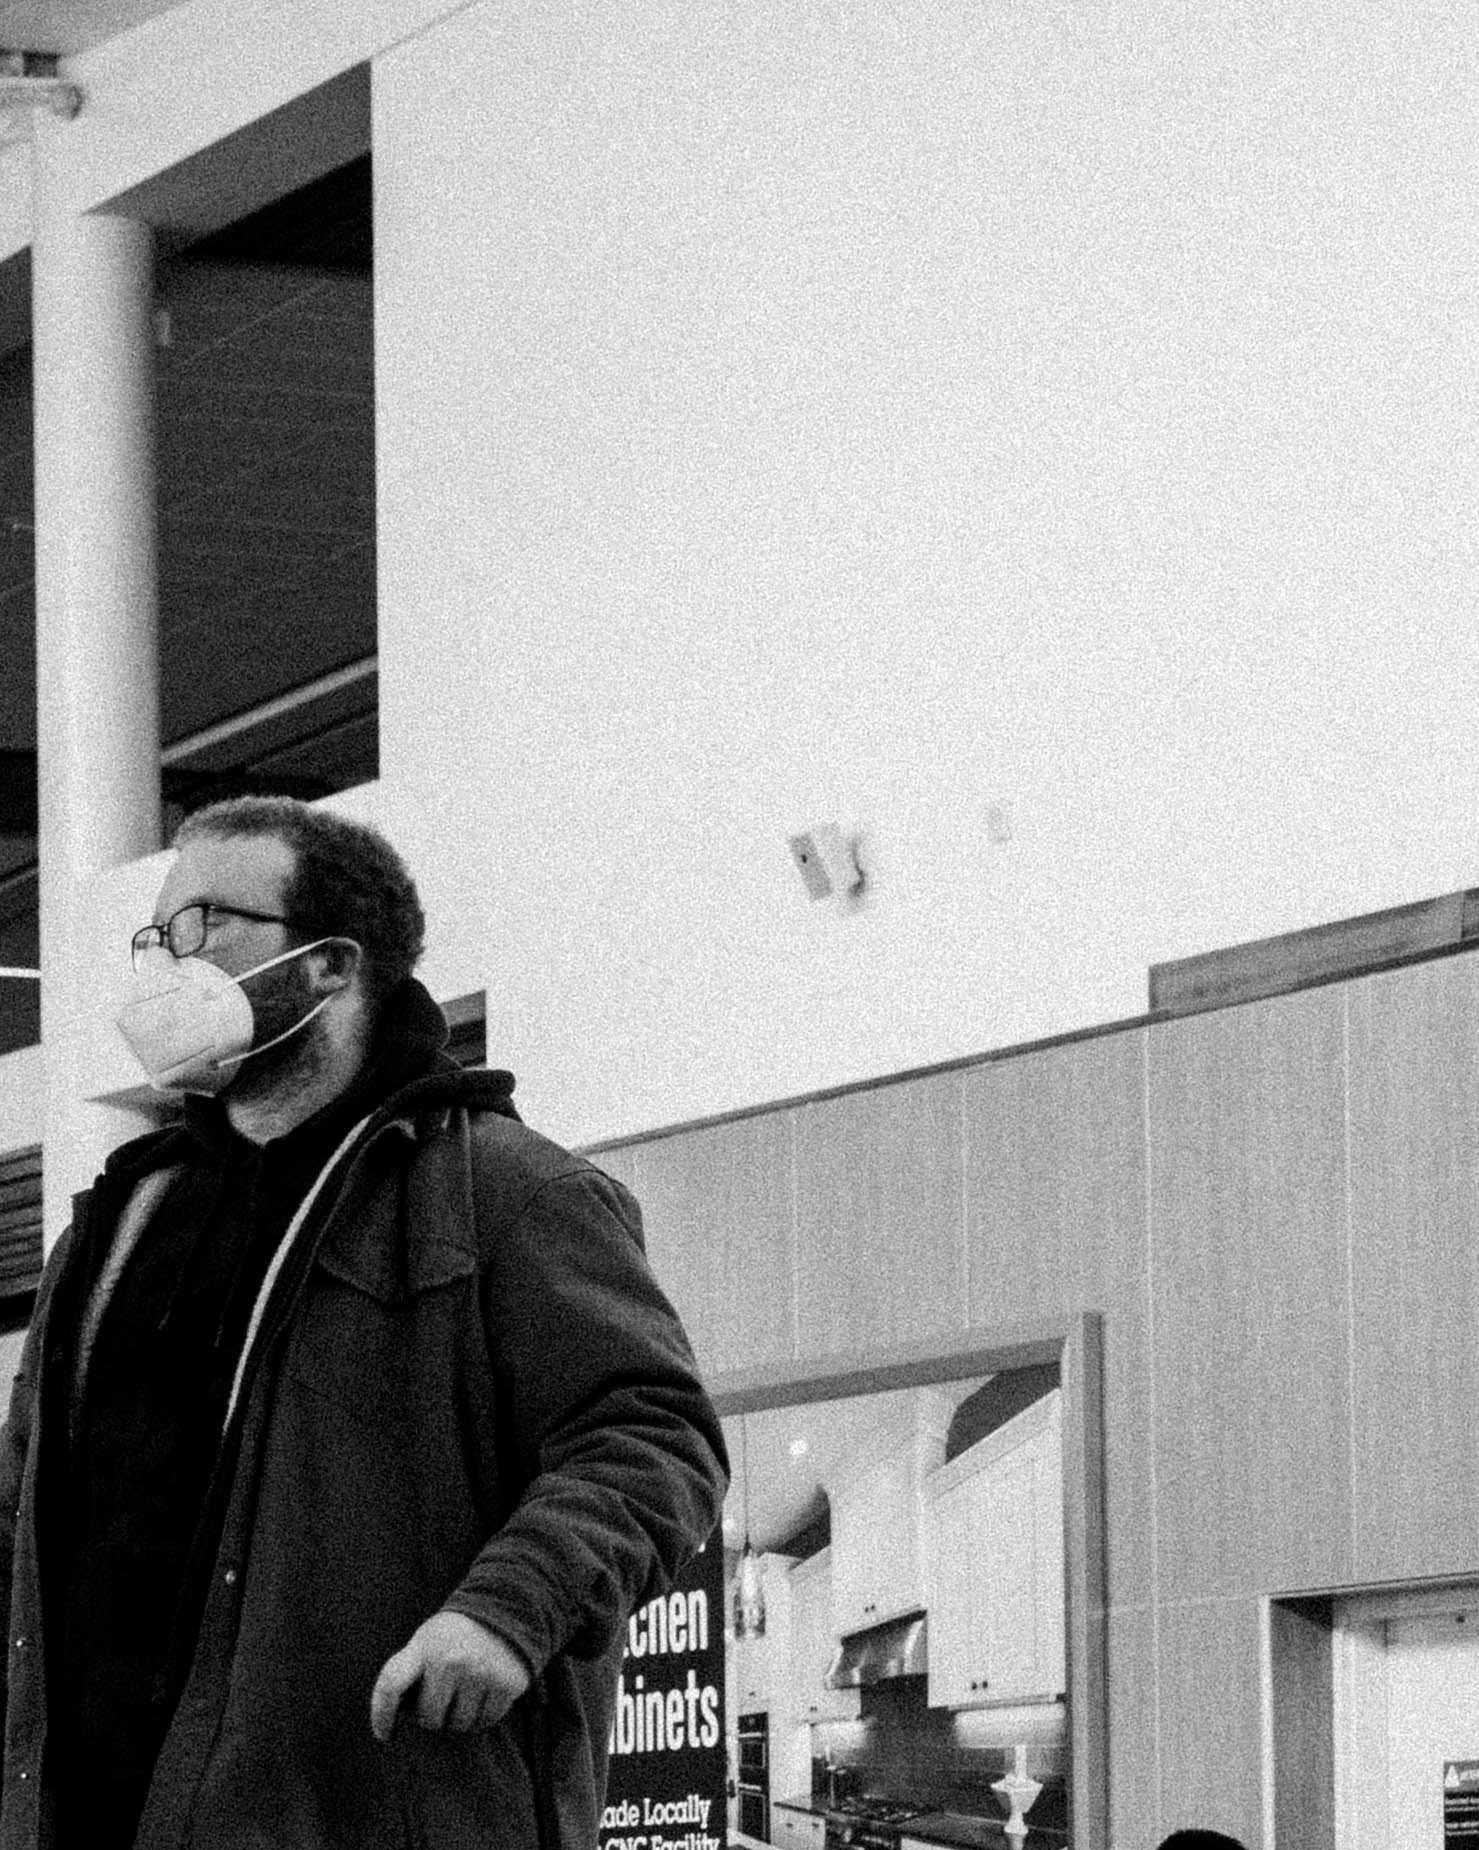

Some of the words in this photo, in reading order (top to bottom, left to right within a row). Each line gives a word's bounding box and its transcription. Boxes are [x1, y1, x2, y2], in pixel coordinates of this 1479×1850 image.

[624, 1589, 709, 1658] chen
[609, 1669, 720, 1755] binets
[600, 1799, 640, 1829] ade
[643, 1793, 712, 1829] Locally
